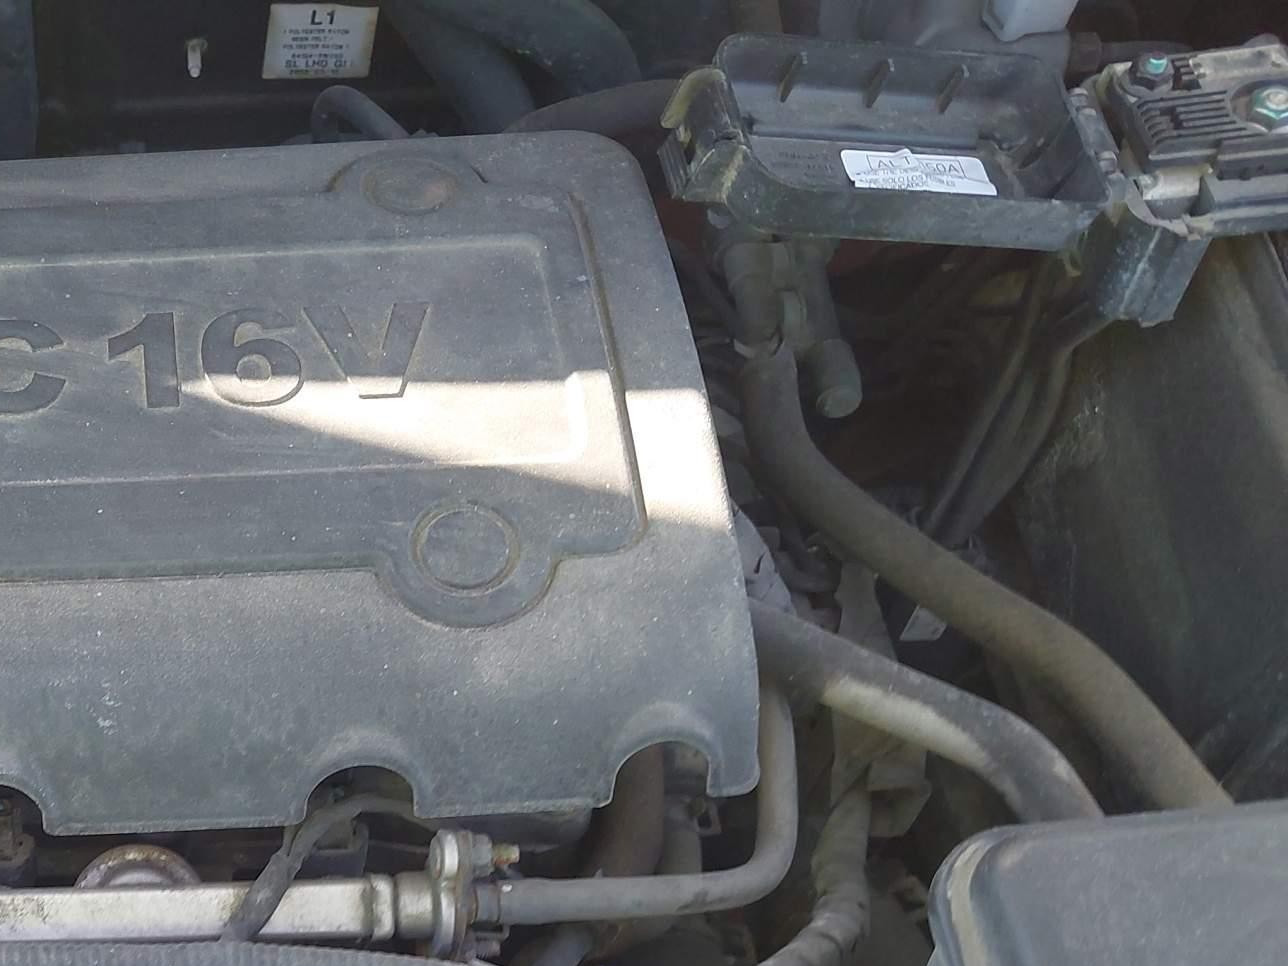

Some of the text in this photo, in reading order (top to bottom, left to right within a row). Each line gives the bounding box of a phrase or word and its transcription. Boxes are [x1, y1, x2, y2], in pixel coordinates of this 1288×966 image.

[310, 9, 336, 25] L1
[305, 60, 328, 68] LHD
[108, 301, 429, 408] 16V
